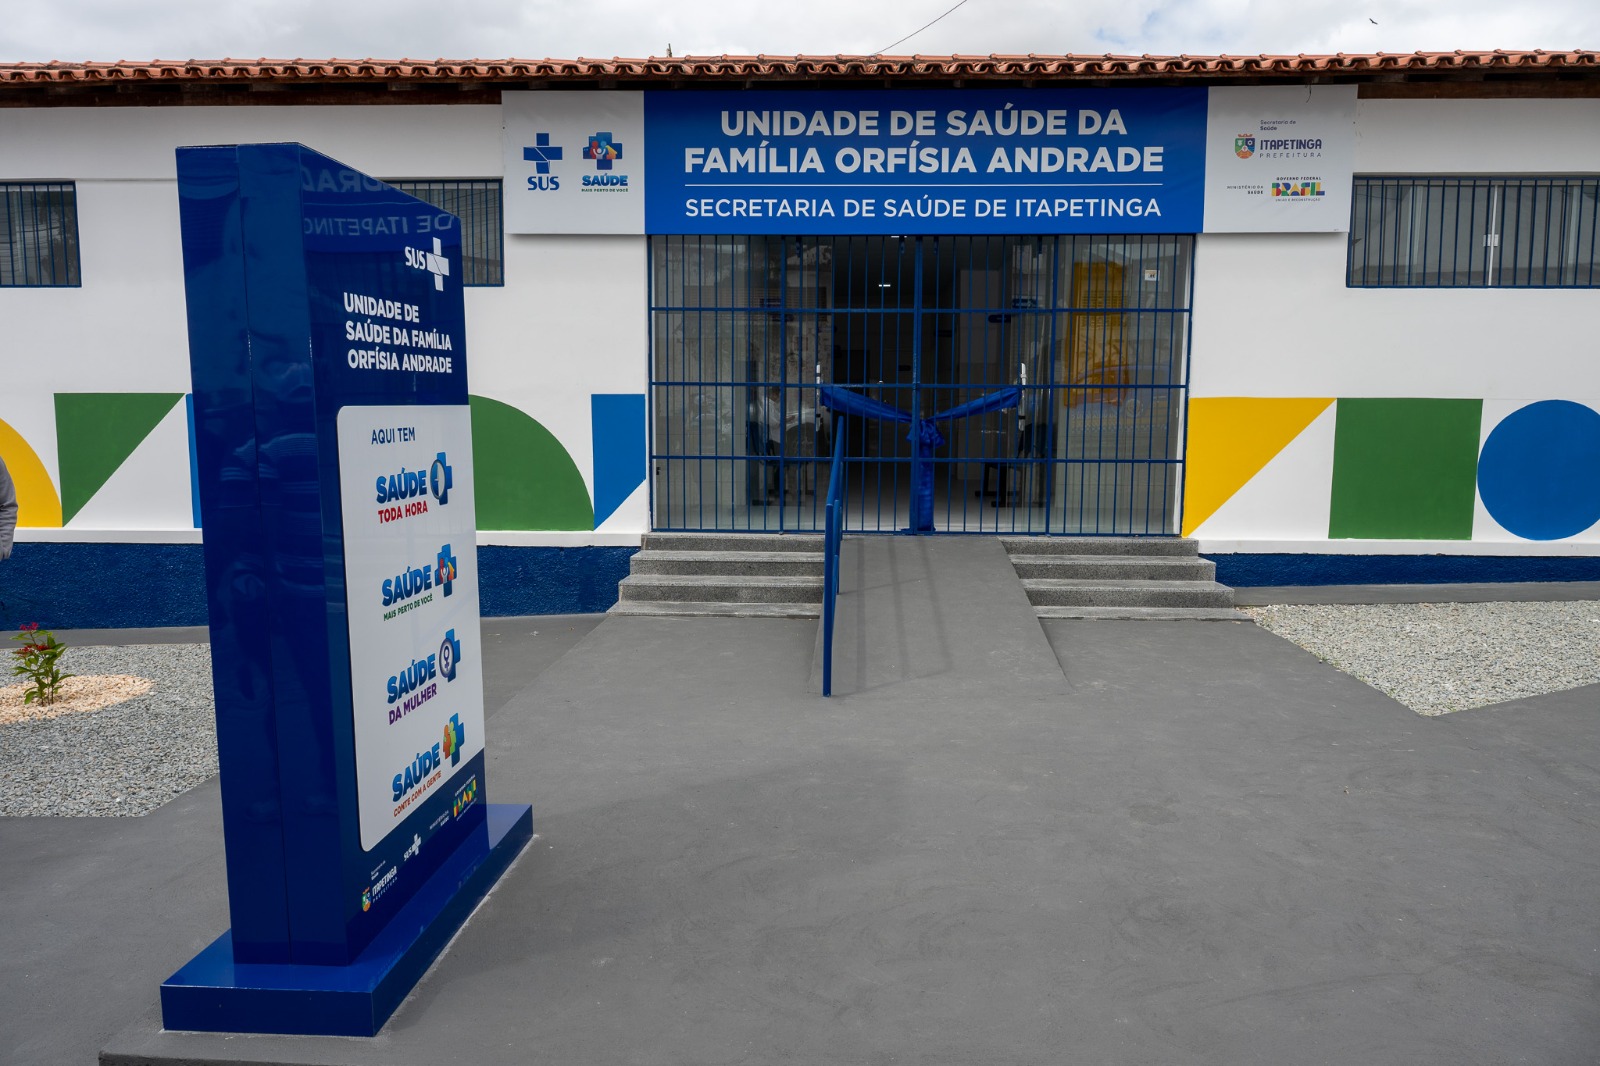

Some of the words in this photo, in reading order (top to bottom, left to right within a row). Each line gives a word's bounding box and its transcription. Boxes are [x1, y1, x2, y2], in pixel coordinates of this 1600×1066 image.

[721, 110, 879, 136] UNIDADE
[890, 110, 936, 136] DE
[946, 102, 1067, 136] SAÚDE
[1078, 109, 1128, 135] DA
[684, 140, 825, 173] FAMÍLIA
[835, 140, 977, 173] ORFÍSIA
[986, 146, 1164, 173] ANDRADE
[1260, 139, 1322, 150] ITAPETINGA
[527, 176, 560, 191] SUS
[582, 173, 629, 187] SAÚDE
[1271, 182, 1325, 196] BRASIL
[685, 198, 835, 217] SECRETARIA
[844, 198, 876, 217] DE
[883, 194, 966, 217] SAÚDE
[975, 198, 1007, 217] DE
[1015, 198, 1162, 217] ITAPETINGA
[404, 246, 426, 269] SUS
[343, 292, 402, 320] UNIDADE
[404, 303, 420, 323] DE
[345, 318, 391, 345] SAÚDE
[393, 328, 410, 347] DA
[411, 328, 452, 351] FAMÍLIA
[347, 346, 400, 371] ORFÍSIA
[402, 354, 452, 373] ANDRADE
[371, 428, 395, 445] AQUI
[397, 427, 416, 442] TEM
[376, 467, 427, 504] SAÚDE
[378, 505, 403, 524] TODA
[405, 500, 428, 518] HORA
[381, 566, 433, 606] SAÚDE
[383, 608, 397, 621] MAIS
[397, 601, 413, 616] PERTO
[414, 598, 421, 609] DE
[420, 593, 433, 605] VOCÊ
[386, 653, 436, 704] SAÚDE
[388, 707, 402, 725] DA
[403, 683, 437, 717] MULHER
[392, 742, 441, 802] SAÚDE
[393, 797, 411, 817] CONTE
[411, 788, 423, 802] COM
[426, 770, 442, 788] GENTE
[372, 866, 397, 897] ITAPETINGA
